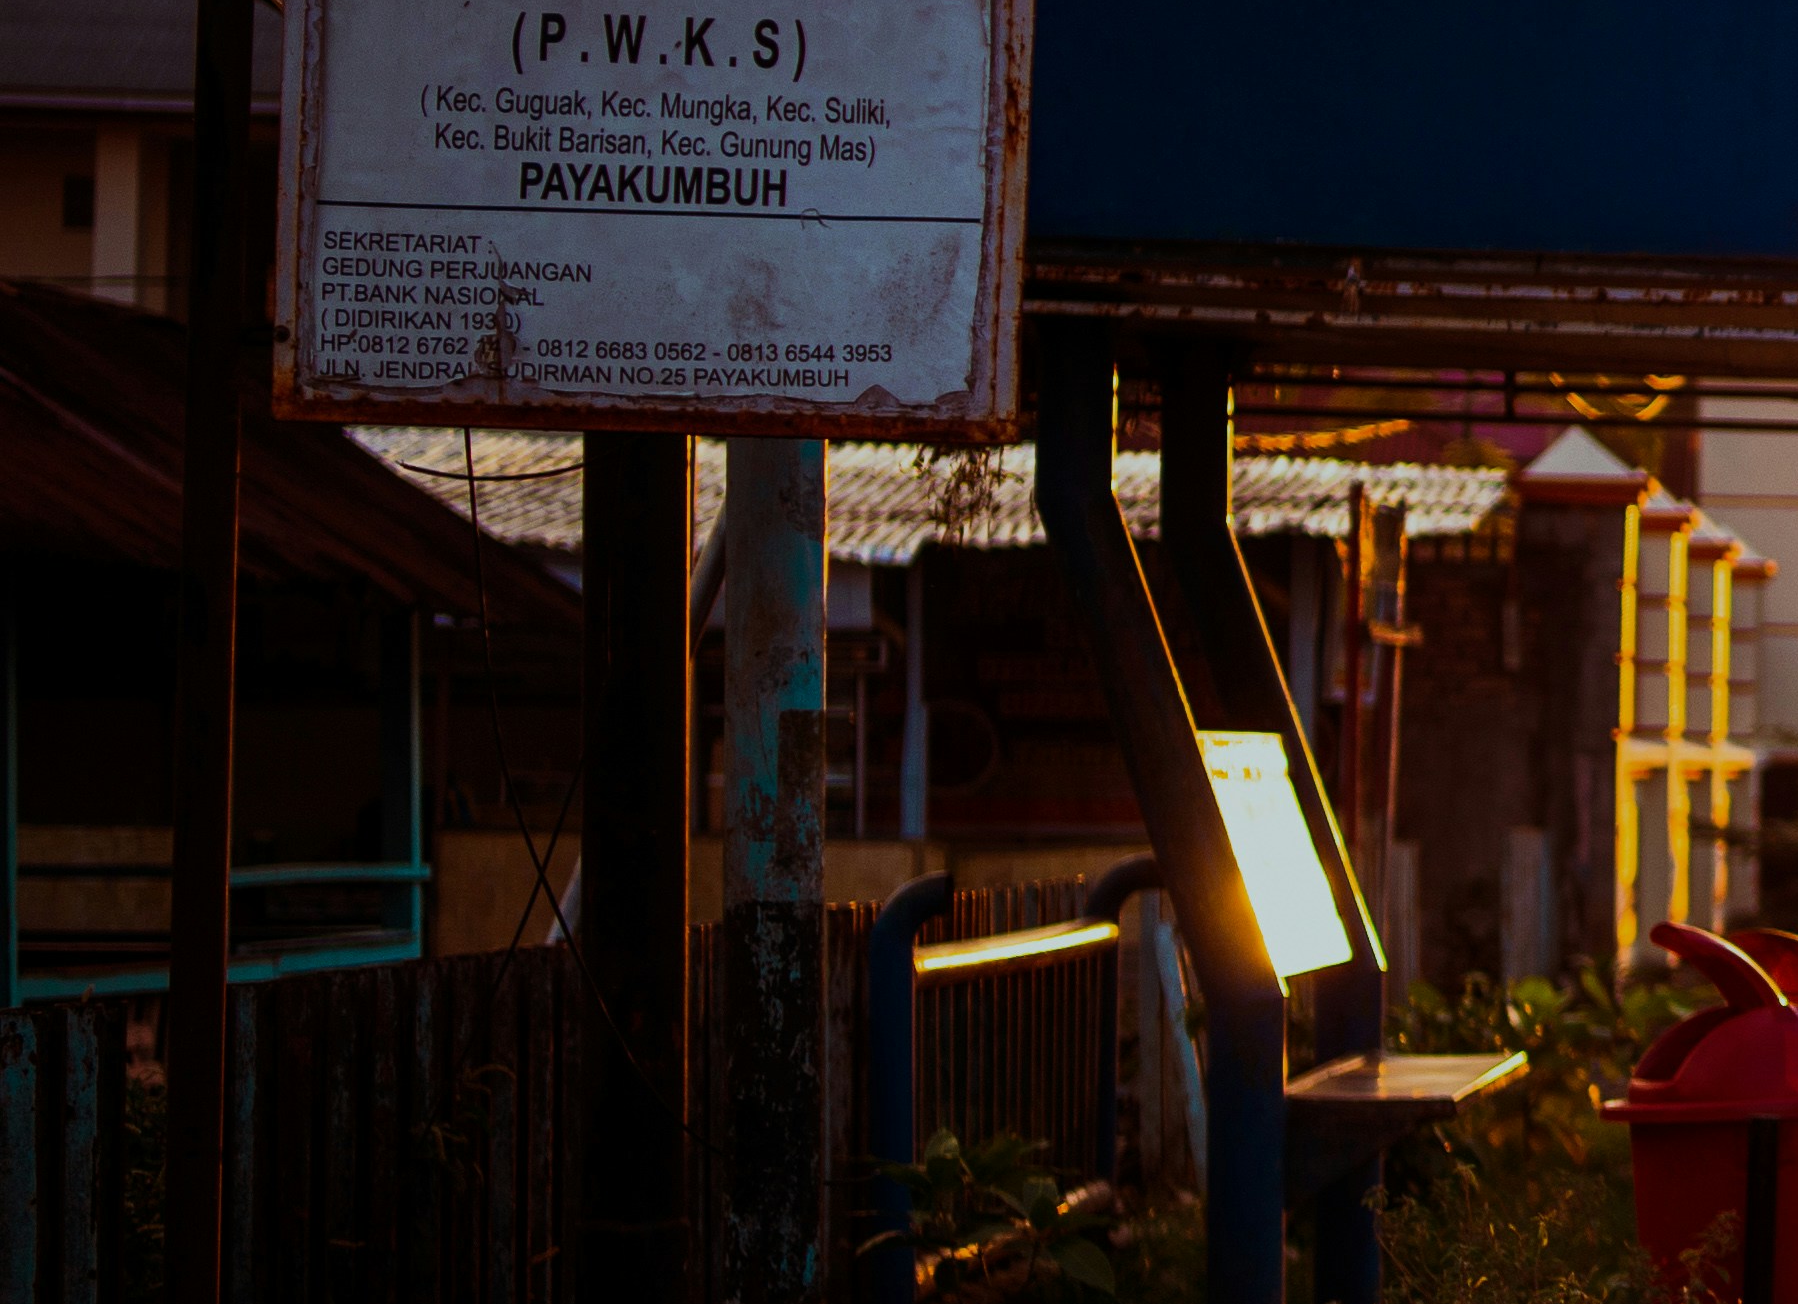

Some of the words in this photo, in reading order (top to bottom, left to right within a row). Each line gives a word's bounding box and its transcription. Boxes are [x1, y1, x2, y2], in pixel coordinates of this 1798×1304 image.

[495, 87, 592, 121] Guguak,
[601, 90, 651, 117] Kec.
[660, 92, 758, 126] Mungka,
[766, 95, 816, 122] Kec.
[825, 96, 891, 129] Suliki,
[435, 122, 485, 149] Kec.
[494, 124, 552, 151] Bukit
[559, 126, 652, 159] Barisan,
[661, 129, 711, 156] Kec.
[720, 131, 811, 167] Gunung
[819, 134, 876, 168] Mas)
[519, 161, 787, 207] PAYAKUMBUH
[323, 231, 482, 254] SEKRETARIAT
[322, 257, 422, 278] GEDUNG
[430, 261, 592, 283] PERJUANGAN
[321, 283, 417, 304] PT.BANK
[416, 337, 469, 355] 6762
[537, 339, 589, 359] 0812
[595, 341, 647, 360] 6683
[654, 342, 706, 362] 0562
[727, 343, 779, 362] 0813
[785, 344, 835, 363] 6544
[842, 344, 892, 363] 3953
[318, 358, 366, 378] JLN.
[619, 366, 687, 385] NO.25
[694, 368, 850, 387] PAYAKUMBUH
